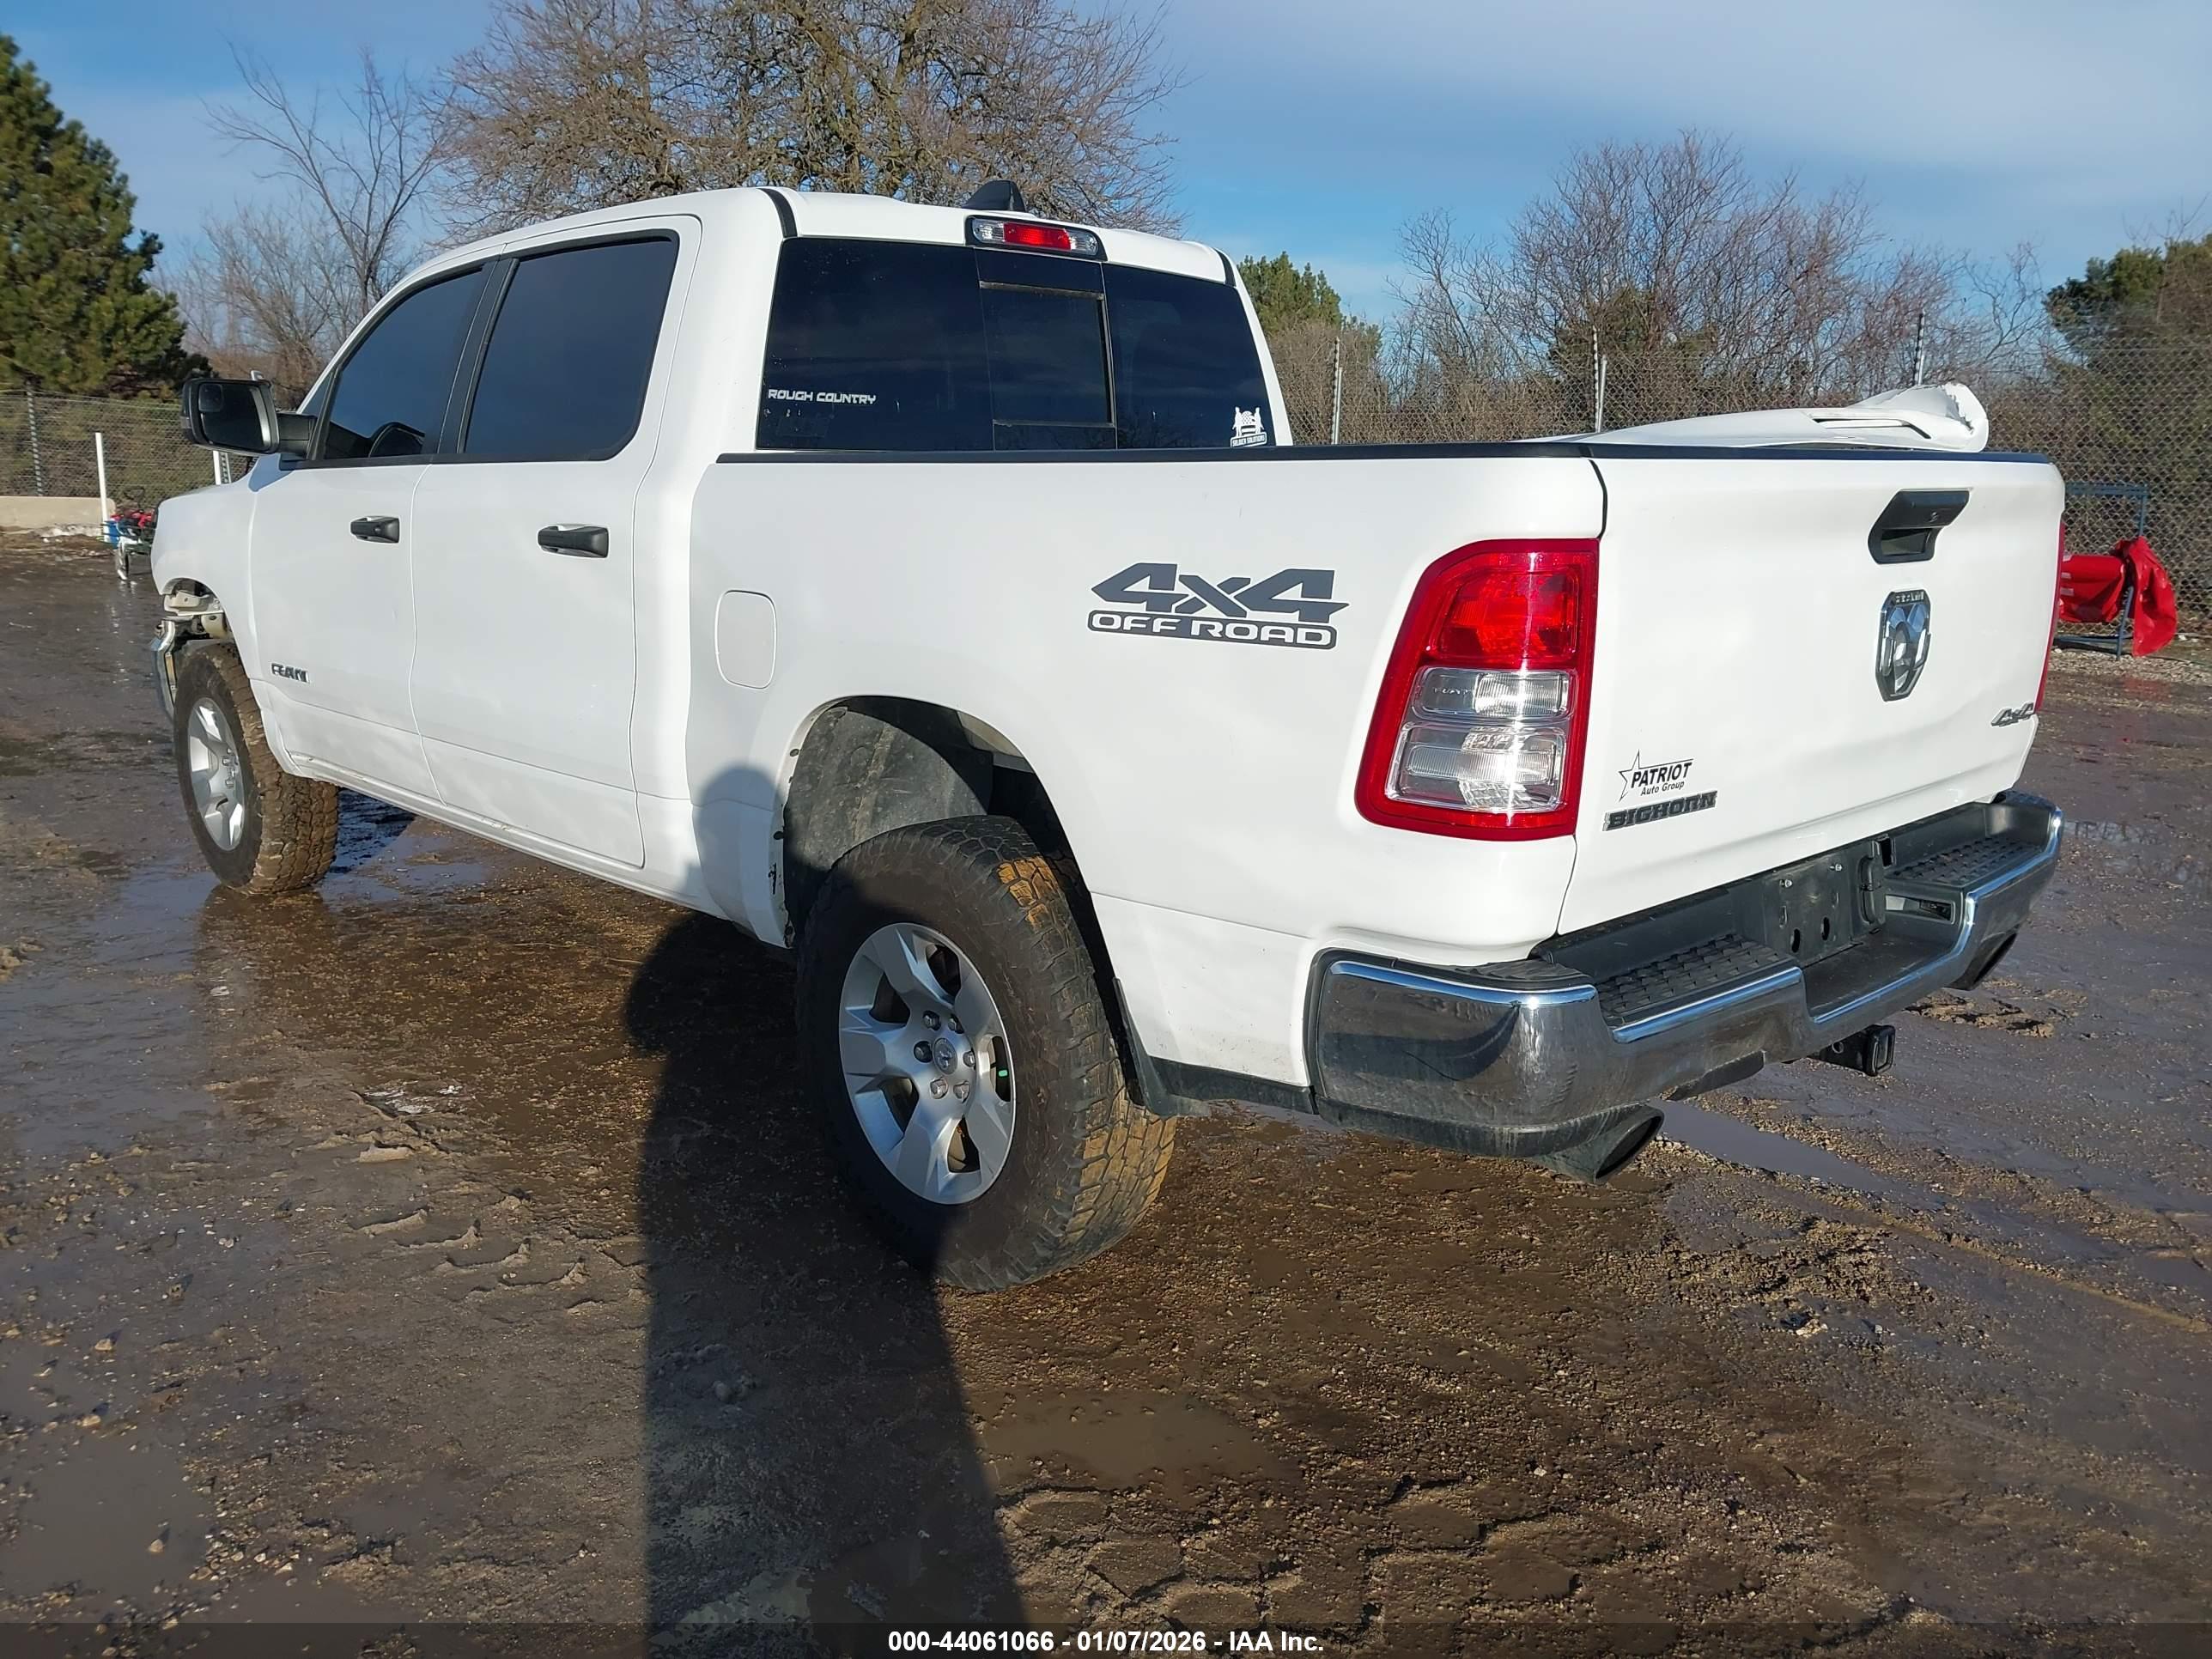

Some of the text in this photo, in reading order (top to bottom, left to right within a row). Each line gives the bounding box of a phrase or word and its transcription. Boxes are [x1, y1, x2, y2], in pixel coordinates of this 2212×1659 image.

[768, 388, 877, 404] ROUGH COUNTRY
[1091, 611, 1333, 647] OFF ROAD
[270, 662, 310, 684] RAM
[1631, 762, 1693, 788] PATRIOT
[1640, 781, 1685, 796] Auto Group
